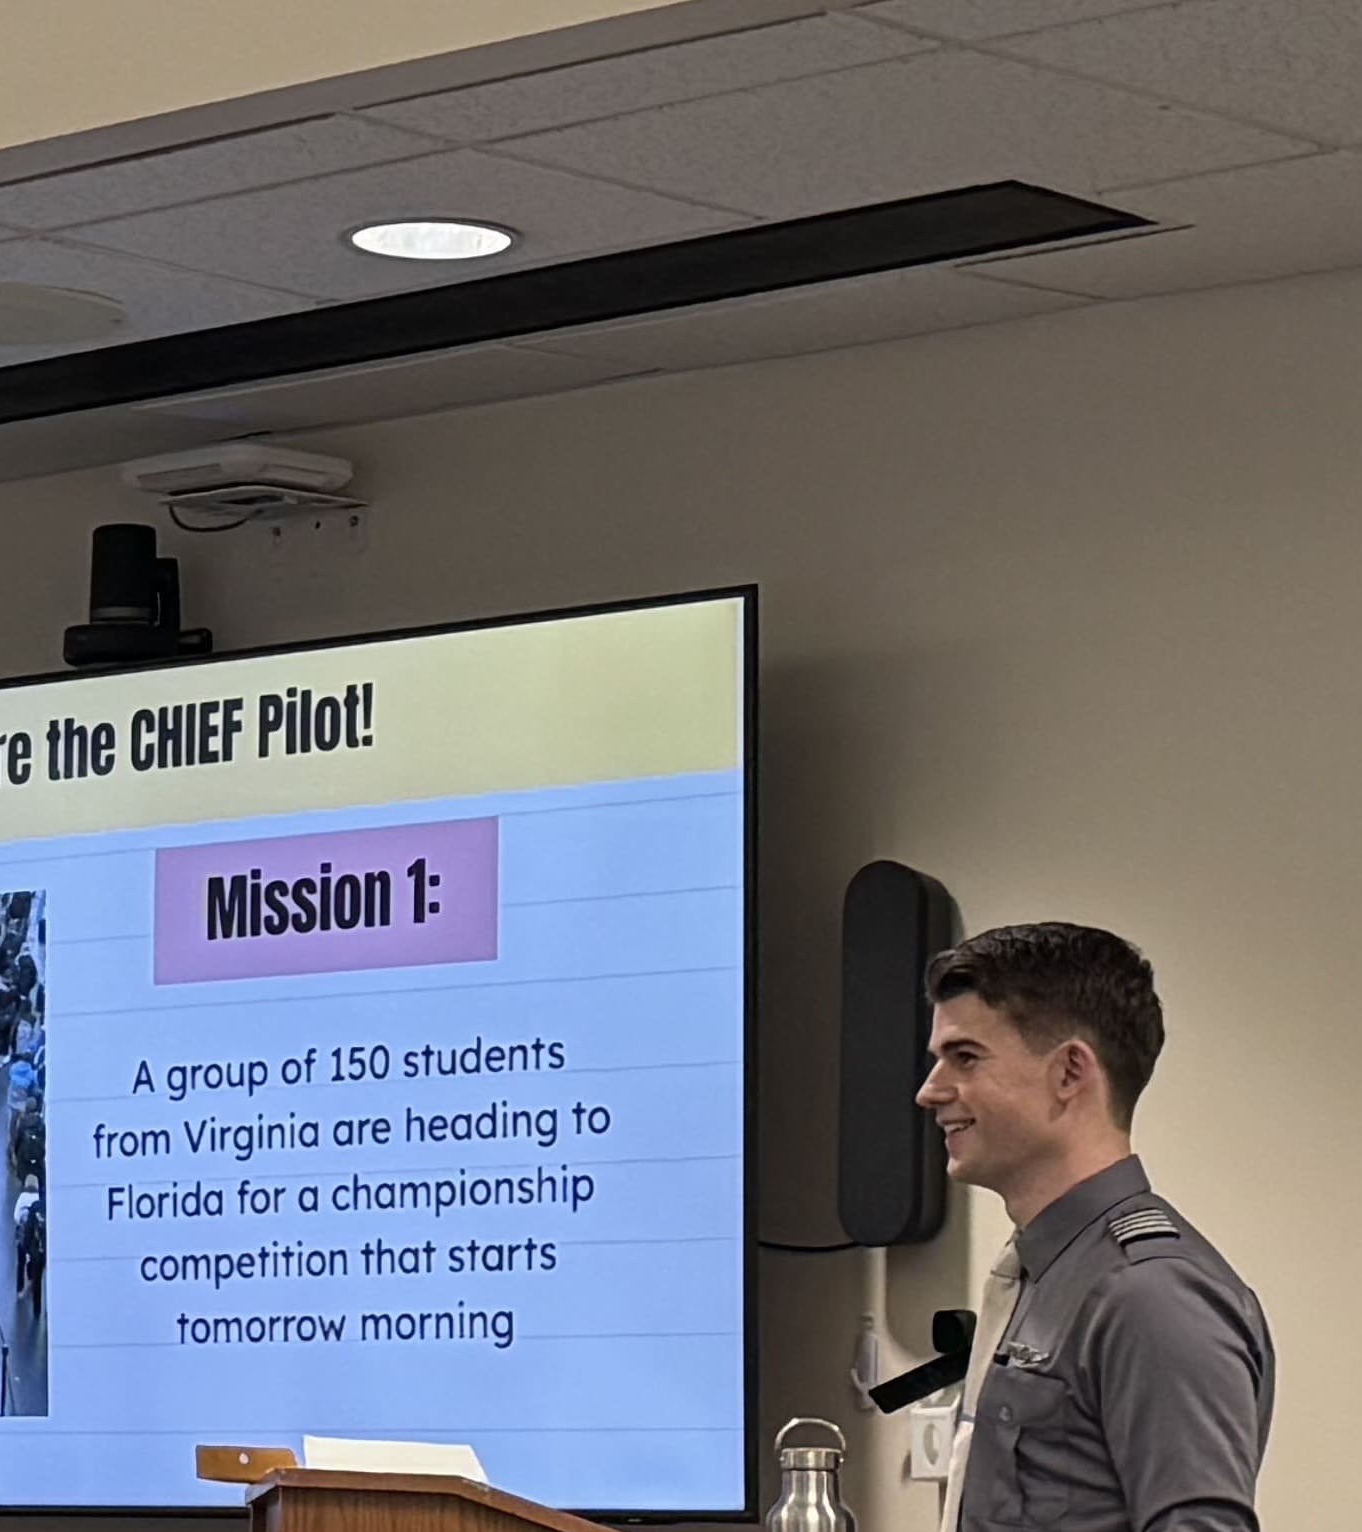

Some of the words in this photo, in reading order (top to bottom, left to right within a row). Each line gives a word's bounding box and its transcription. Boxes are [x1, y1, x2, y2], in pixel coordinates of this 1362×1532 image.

[45, 717, 116, 781] the
[130, 697, 244, 772] CHIEF
[258, 682, 374, 759] Pilot!
[207, 864, 390, 941] Mission
[406, 858, 441, 924] 1:
[132, 1060, 156, 1095] A
[166, 1060, 268, 1102] group
[281, 1047, 317, 1085] of
[331, 1044, 390, 1082] 150
[403, 1036, 565, 1078] students
[92, 1123, 171, 1159] from
[183, 1111, 319, 1162] Virginia
[332, 1117, 391, 1147] are
[406, 1100, 558, 1148] heading
[571, 1101, 611, 1135] to
[108, 1180, 223, 1221] Florida
[237, 1179, 287, 1215] for
[297, 1185, 319, 1213] a
[331, 1163, 594, 1218] championship
[140, 1240, 348, 1290] competition
[360, 1237, 437, 1276] that
[448, 1237, 557, 1273] starts
[176, 1312, 346, 1345] tomorrow
[361, 1300, 514, 1349] morning
